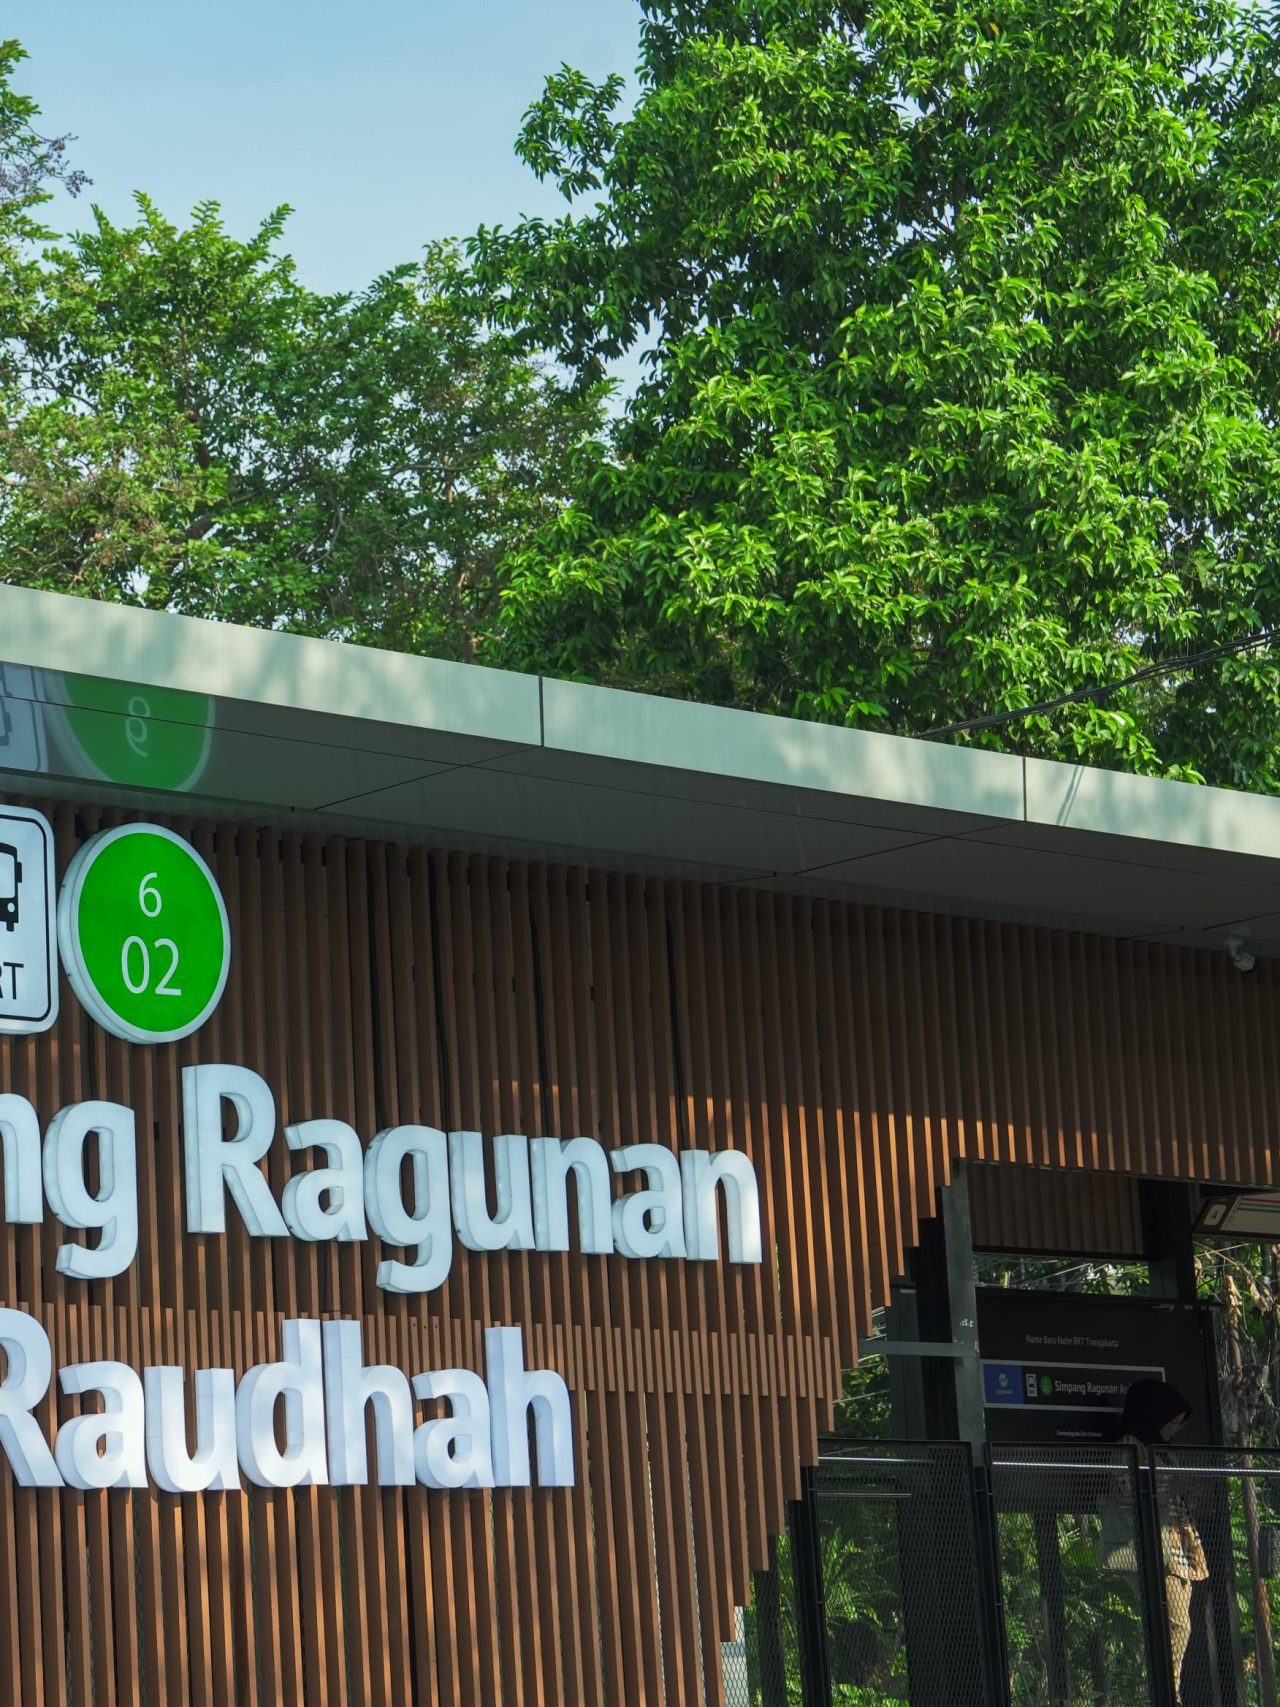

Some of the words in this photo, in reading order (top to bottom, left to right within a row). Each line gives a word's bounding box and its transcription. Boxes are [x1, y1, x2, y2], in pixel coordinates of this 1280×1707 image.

[138, 872, 163, 918] 6
[121, 936, 182, 996] 02
[182, 1064, 762, 1294] Ragunan
[1055, 1380, 1086, 1395] Simpang
[1087, 1382, 1118, 1396] Ragunan
